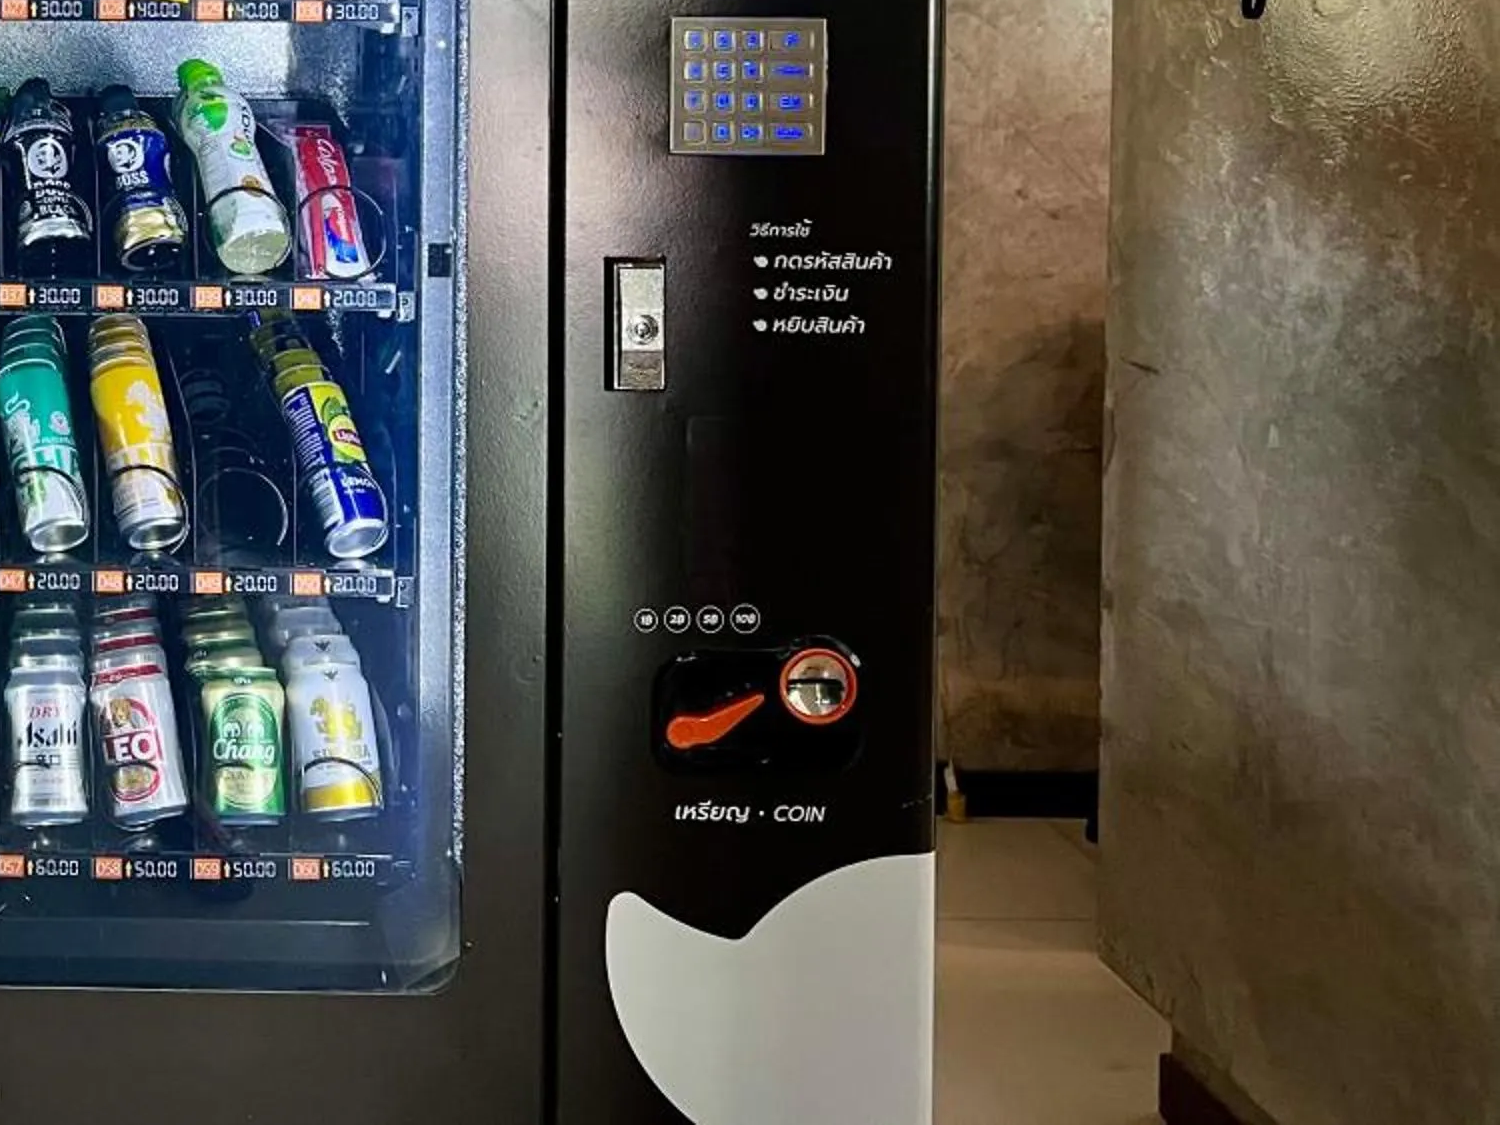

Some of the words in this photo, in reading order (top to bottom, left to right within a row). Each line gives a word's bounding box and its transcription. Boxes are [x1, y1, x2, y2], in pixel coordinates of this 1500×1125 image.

[40, 1, 82, 17] 30.00
[138, 4, 180, 19] 40.00
[335, 4, 379, 20] 30.00
[749, 219, 812, 237] วิธีการใช้
[773, 251, 892, 271] กดรหัสสินค้า
[38, 288, 80, 304] 30.00
[136, 289, 178, 305] 30.00
[234, 290, 277, 306] 30.00
[773, 281, 849, 303] ชำระเงิน
[772, 314, 865, 334] หยิบสินค้า
[37, 572, 80, 590] 20.00
[135, 574, 179, 591] 20.00
[234, 575, 277, 592] 20.00
[18, 720, 78, 748] Asahi
[102, 731, 159, 763] LEO
[212, 737, 276, 763] Chang
[675, 800, 750, 824] เหรียญ
[773, 805, 827, 823] COIN
[35, 858, 79, 876] 60.00
[134, 861, 177, 878] 50.00
[234, 861, 276, 878] 50.00
[332, 860, 375, 877] 60.00
